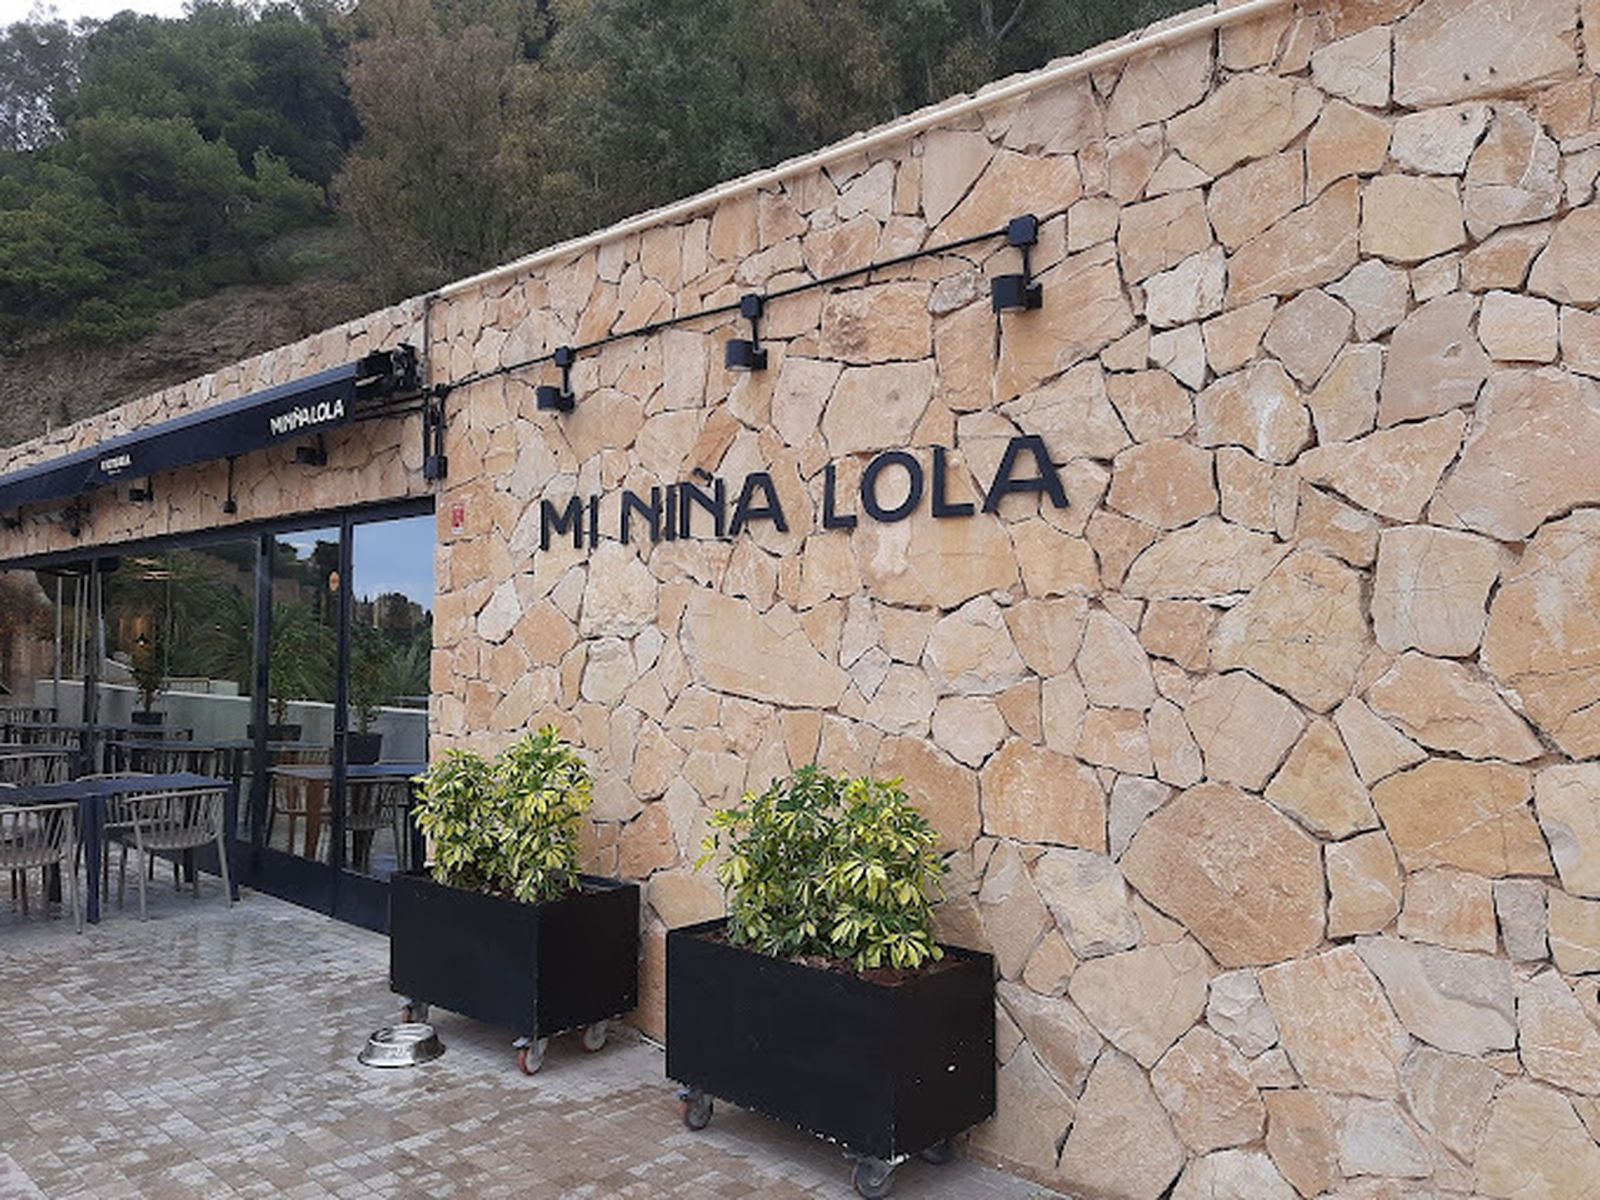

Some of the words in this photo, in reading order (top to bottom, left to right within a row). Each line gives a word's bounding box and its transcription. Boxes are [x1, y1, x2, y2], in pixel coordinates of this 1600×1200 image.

[311, 399, 344, 424] LOLA
[540, 495, 599, 551] MI
[620, 467, 789, 546] NIÑA
[823, 434, 1071, 529] LOLA
